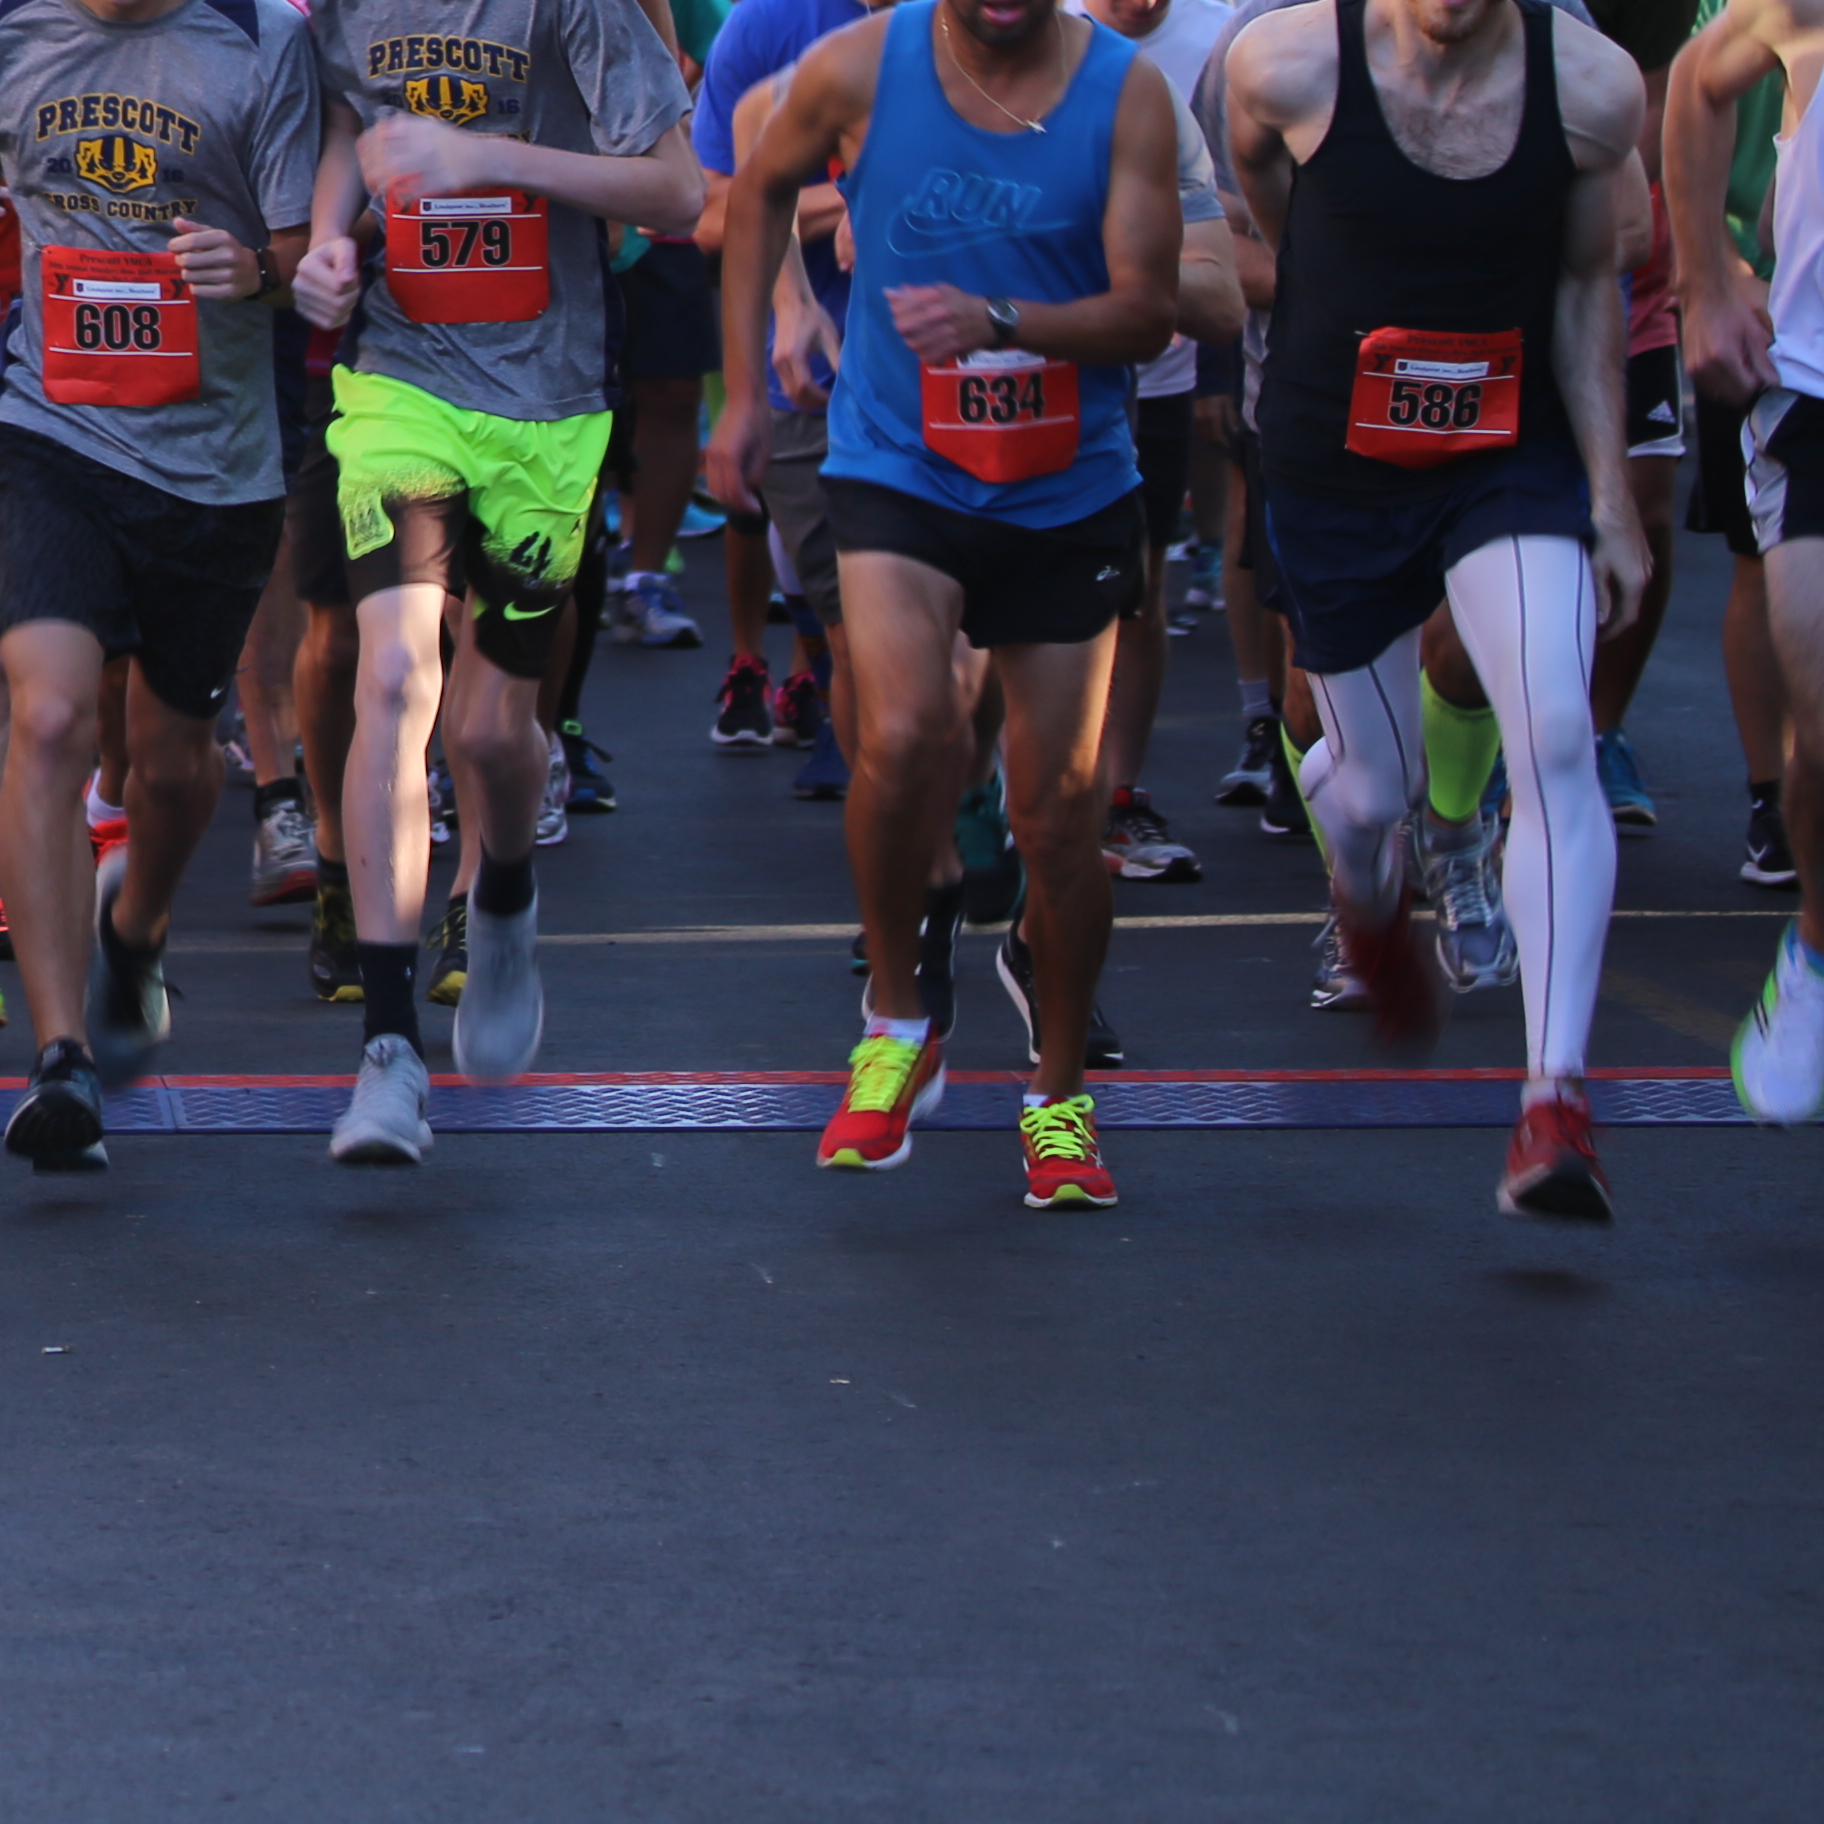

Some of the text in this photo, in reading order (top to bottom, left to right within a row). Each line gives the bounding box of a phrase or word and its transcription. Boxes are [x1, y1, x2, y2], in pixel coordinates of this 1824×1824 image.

[368, 33, 532, 84] PRESCOTT
[36, 92, 202, 156] PRESCOTT
[497, 98, 521, 116] 16
[47, 157, 72, 174] 20
[106, 199, 198, 222] COUNTRY
[909, 167, 1043, 228] RUN
[420, 219, 511, 268] 579
[74, 302, 162, 352] 608
[958, 372, 1045, 426] 634
[1388, 379, 1483, 430] 586
